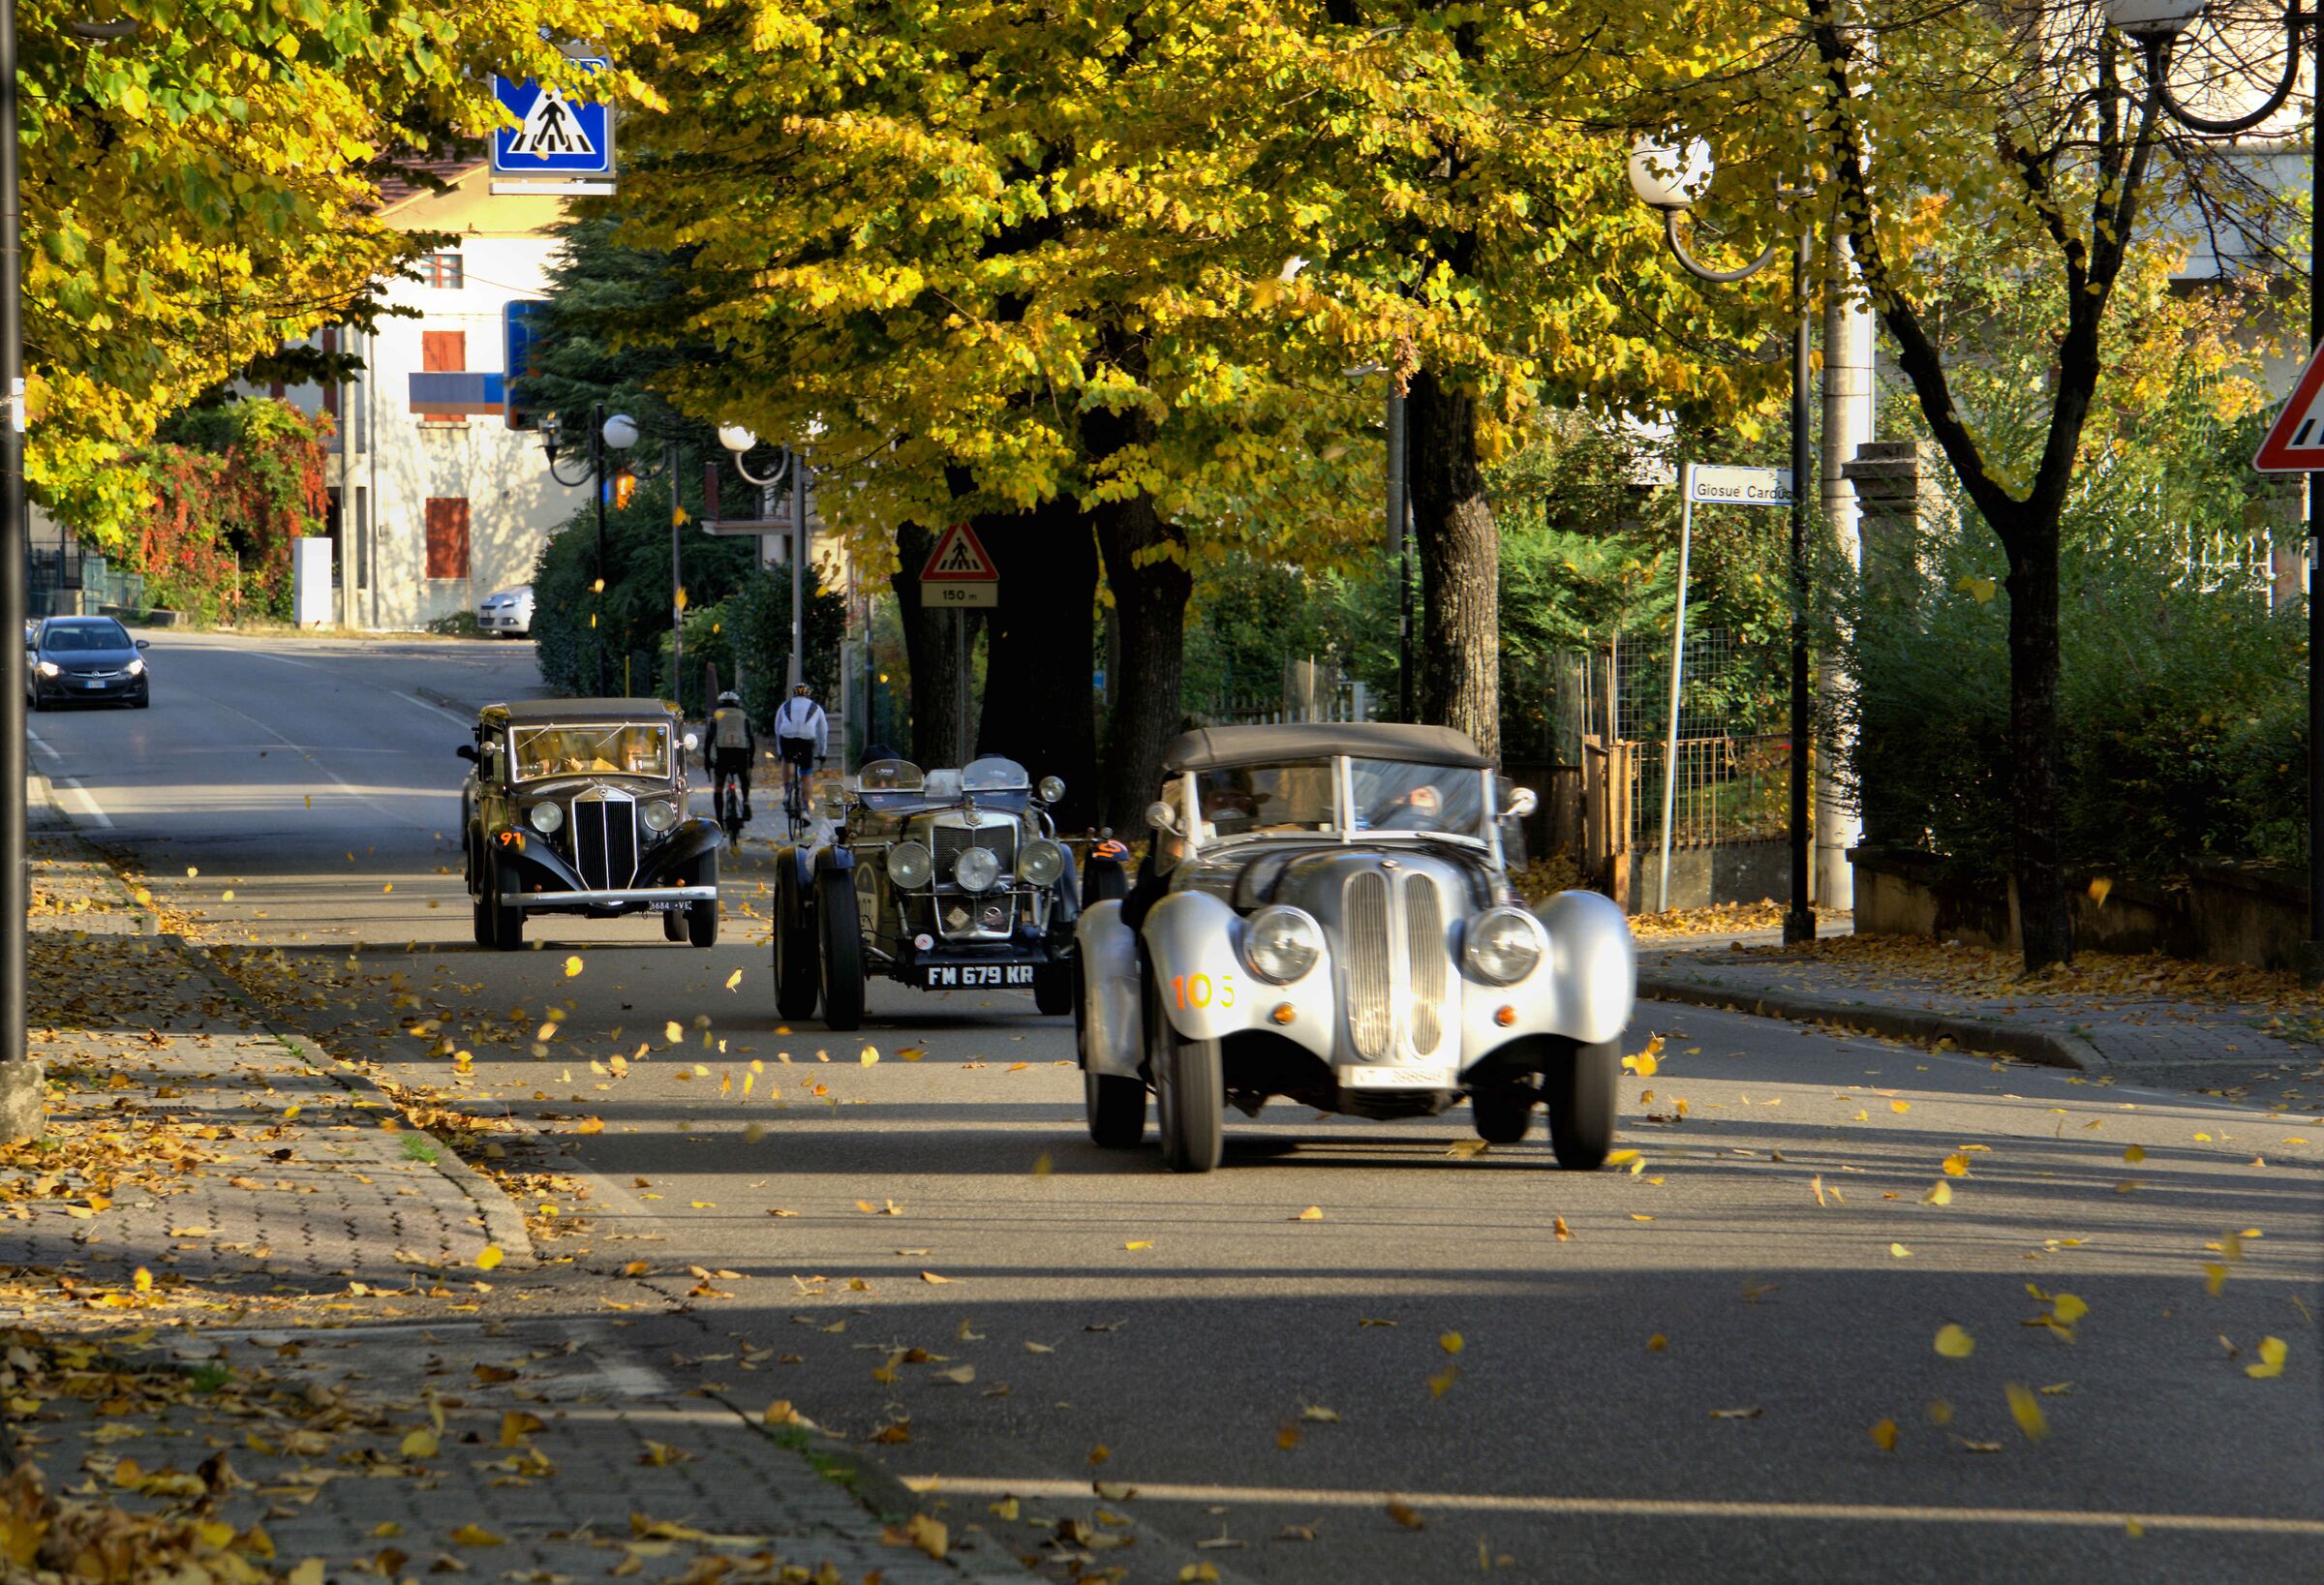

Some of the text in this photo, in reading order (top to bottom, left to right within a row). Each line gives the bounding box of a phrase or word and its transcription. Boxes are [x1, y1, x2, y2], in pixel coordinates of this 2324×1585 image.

[1697, 483, 1741, 498] Giosué
[943, 590, 965, 600] 150
[501, 832, 521, 846] 91
[929, 965, 1034, 985] FM 679 KR
[1170, 973, 1235, 1012] 105
